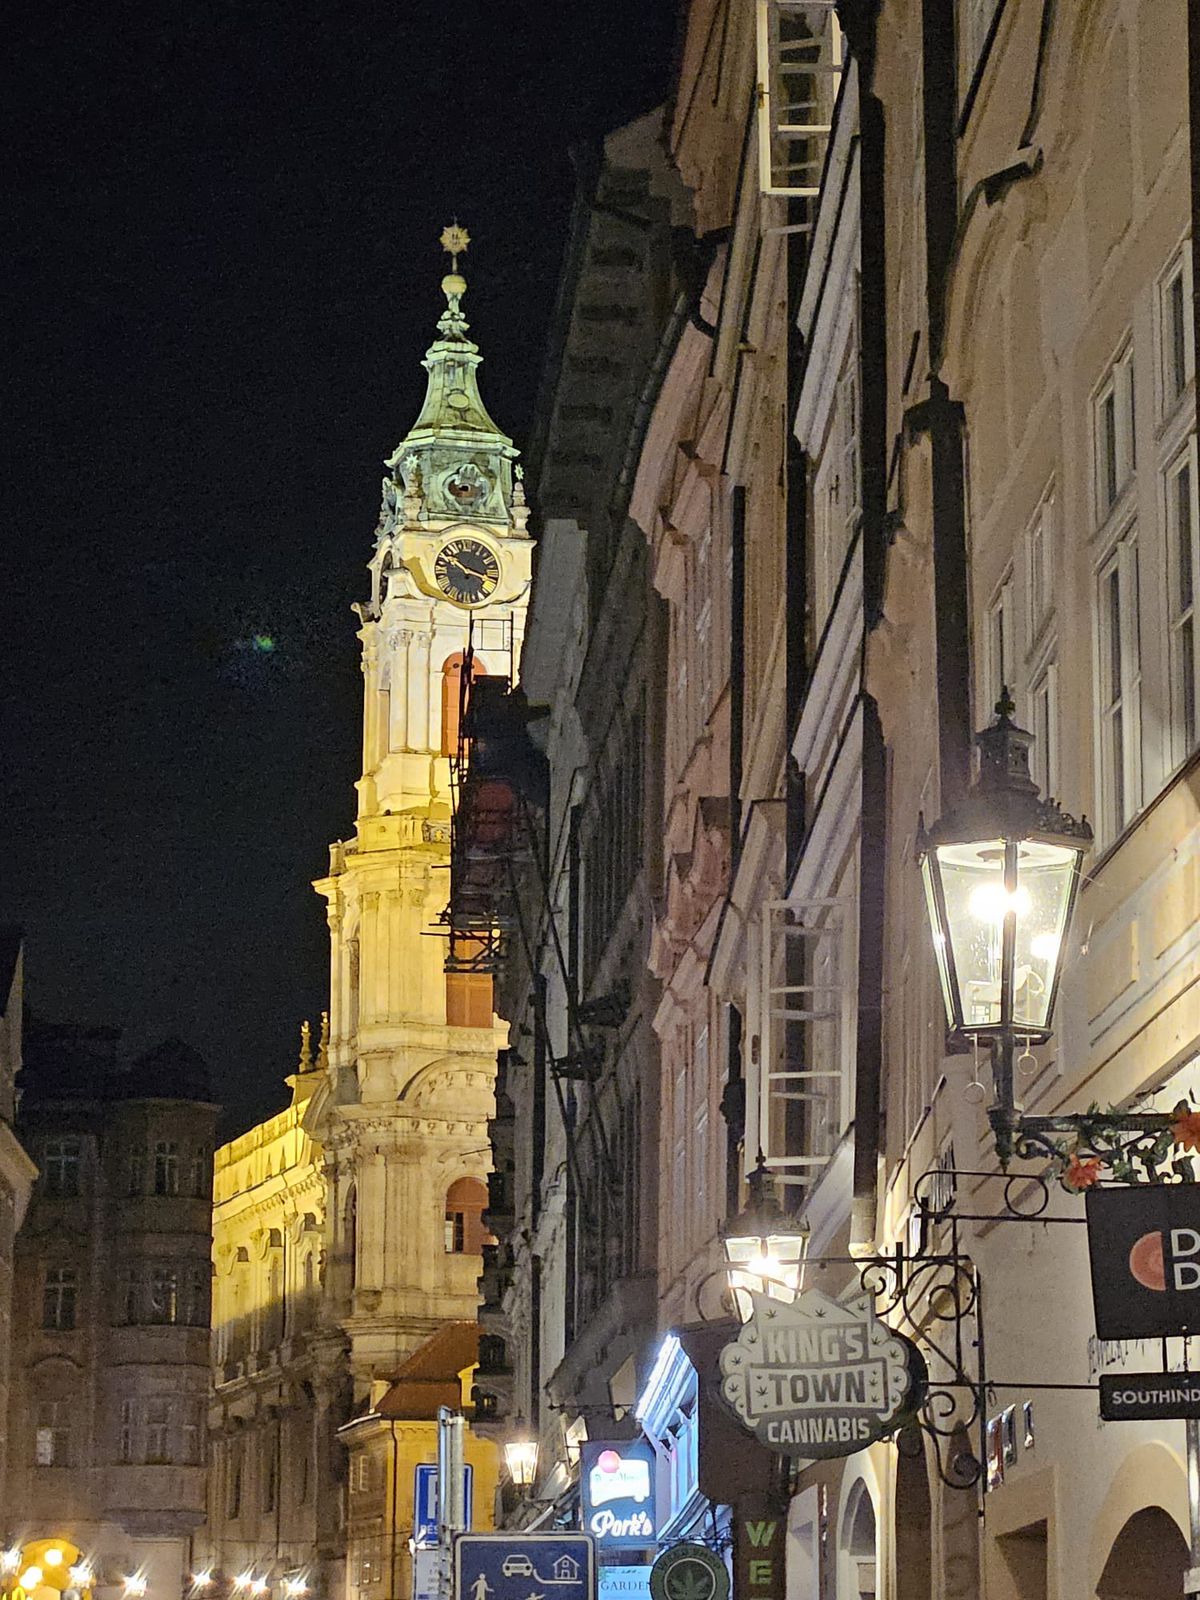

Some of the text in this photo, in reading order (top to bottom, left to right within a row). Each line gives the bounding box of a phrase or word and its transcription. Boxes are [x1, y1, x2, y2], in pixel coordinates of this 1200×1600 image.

[767, 1327, 864, 1363] KING'S
[768, 1370, 867, 1406] TOWN
[767, 1418, 871, 1444] CANNABIS
[591, 1509, 653, 1538] Pork's
